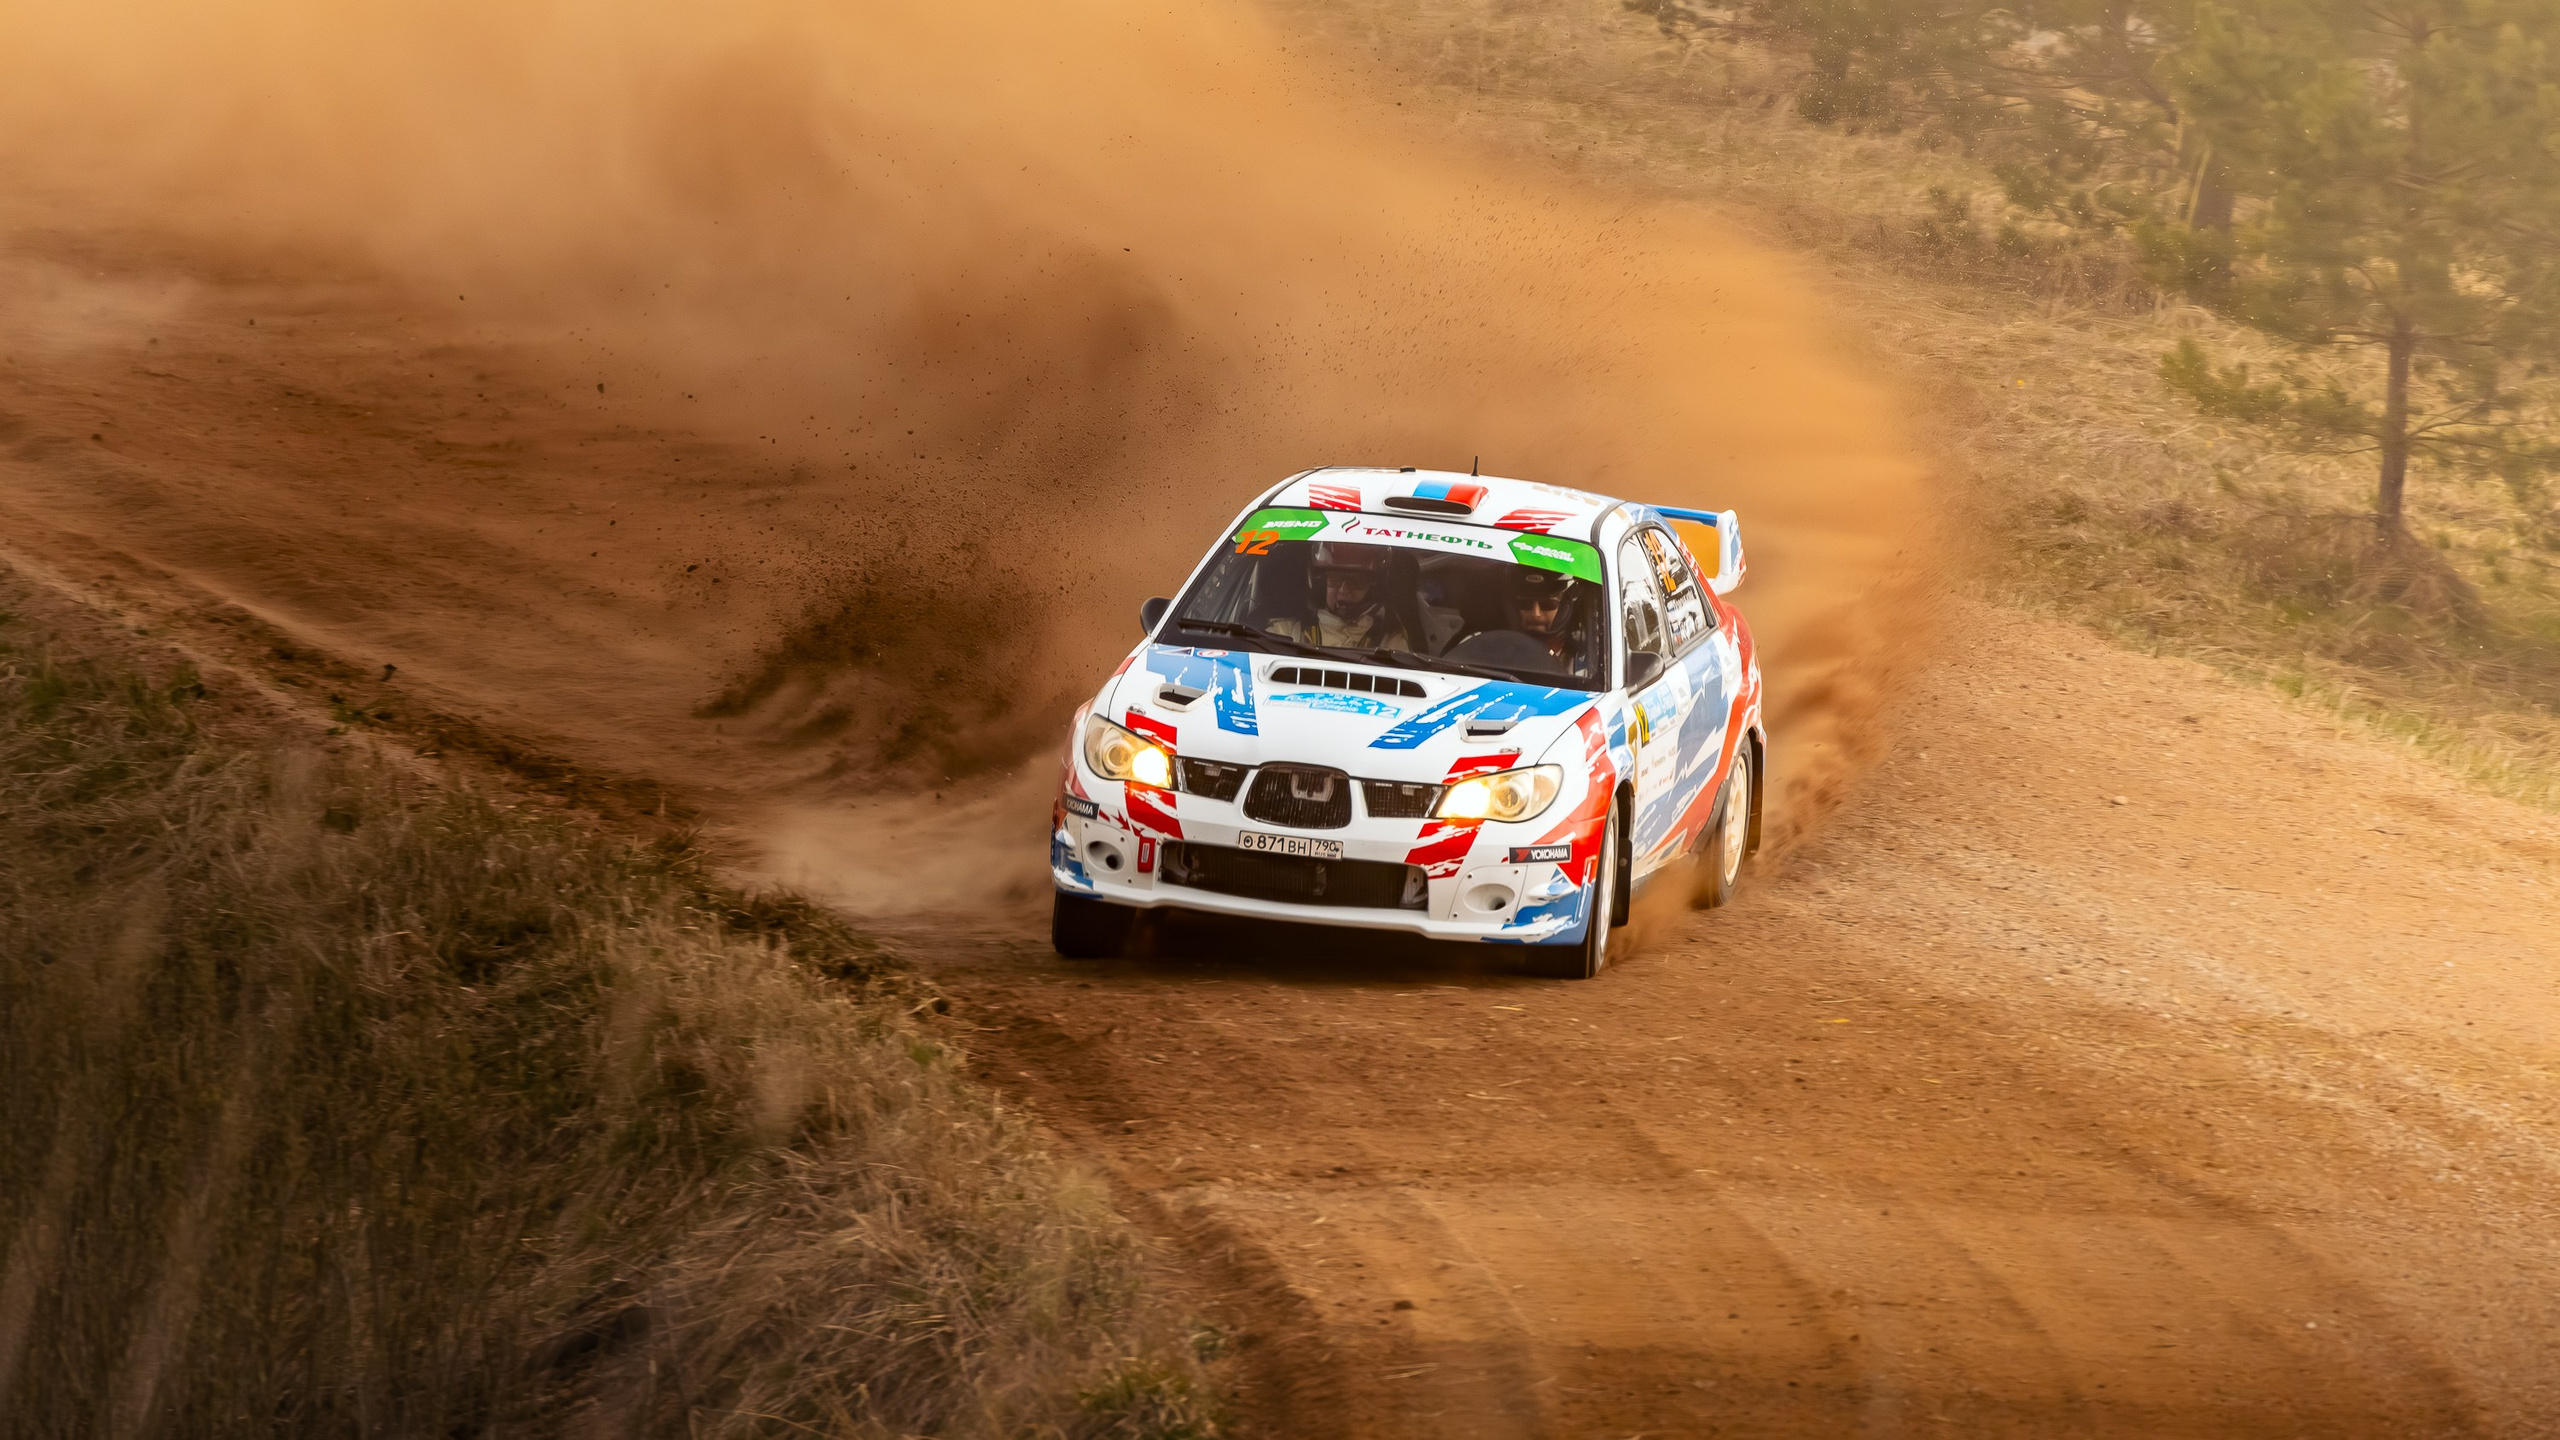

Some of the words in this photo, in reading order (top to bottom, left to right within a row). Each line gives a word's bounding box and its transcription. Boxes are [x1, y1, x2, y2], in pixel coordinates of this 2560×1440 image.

[1235, 529, 1280, 555] 12
[1363, 527, 1493, 549] ТАТНЕФТЬ
[1366, 705, 1398, 717] 12
[1530, 847, 1568, 860] YOKOHAMA
